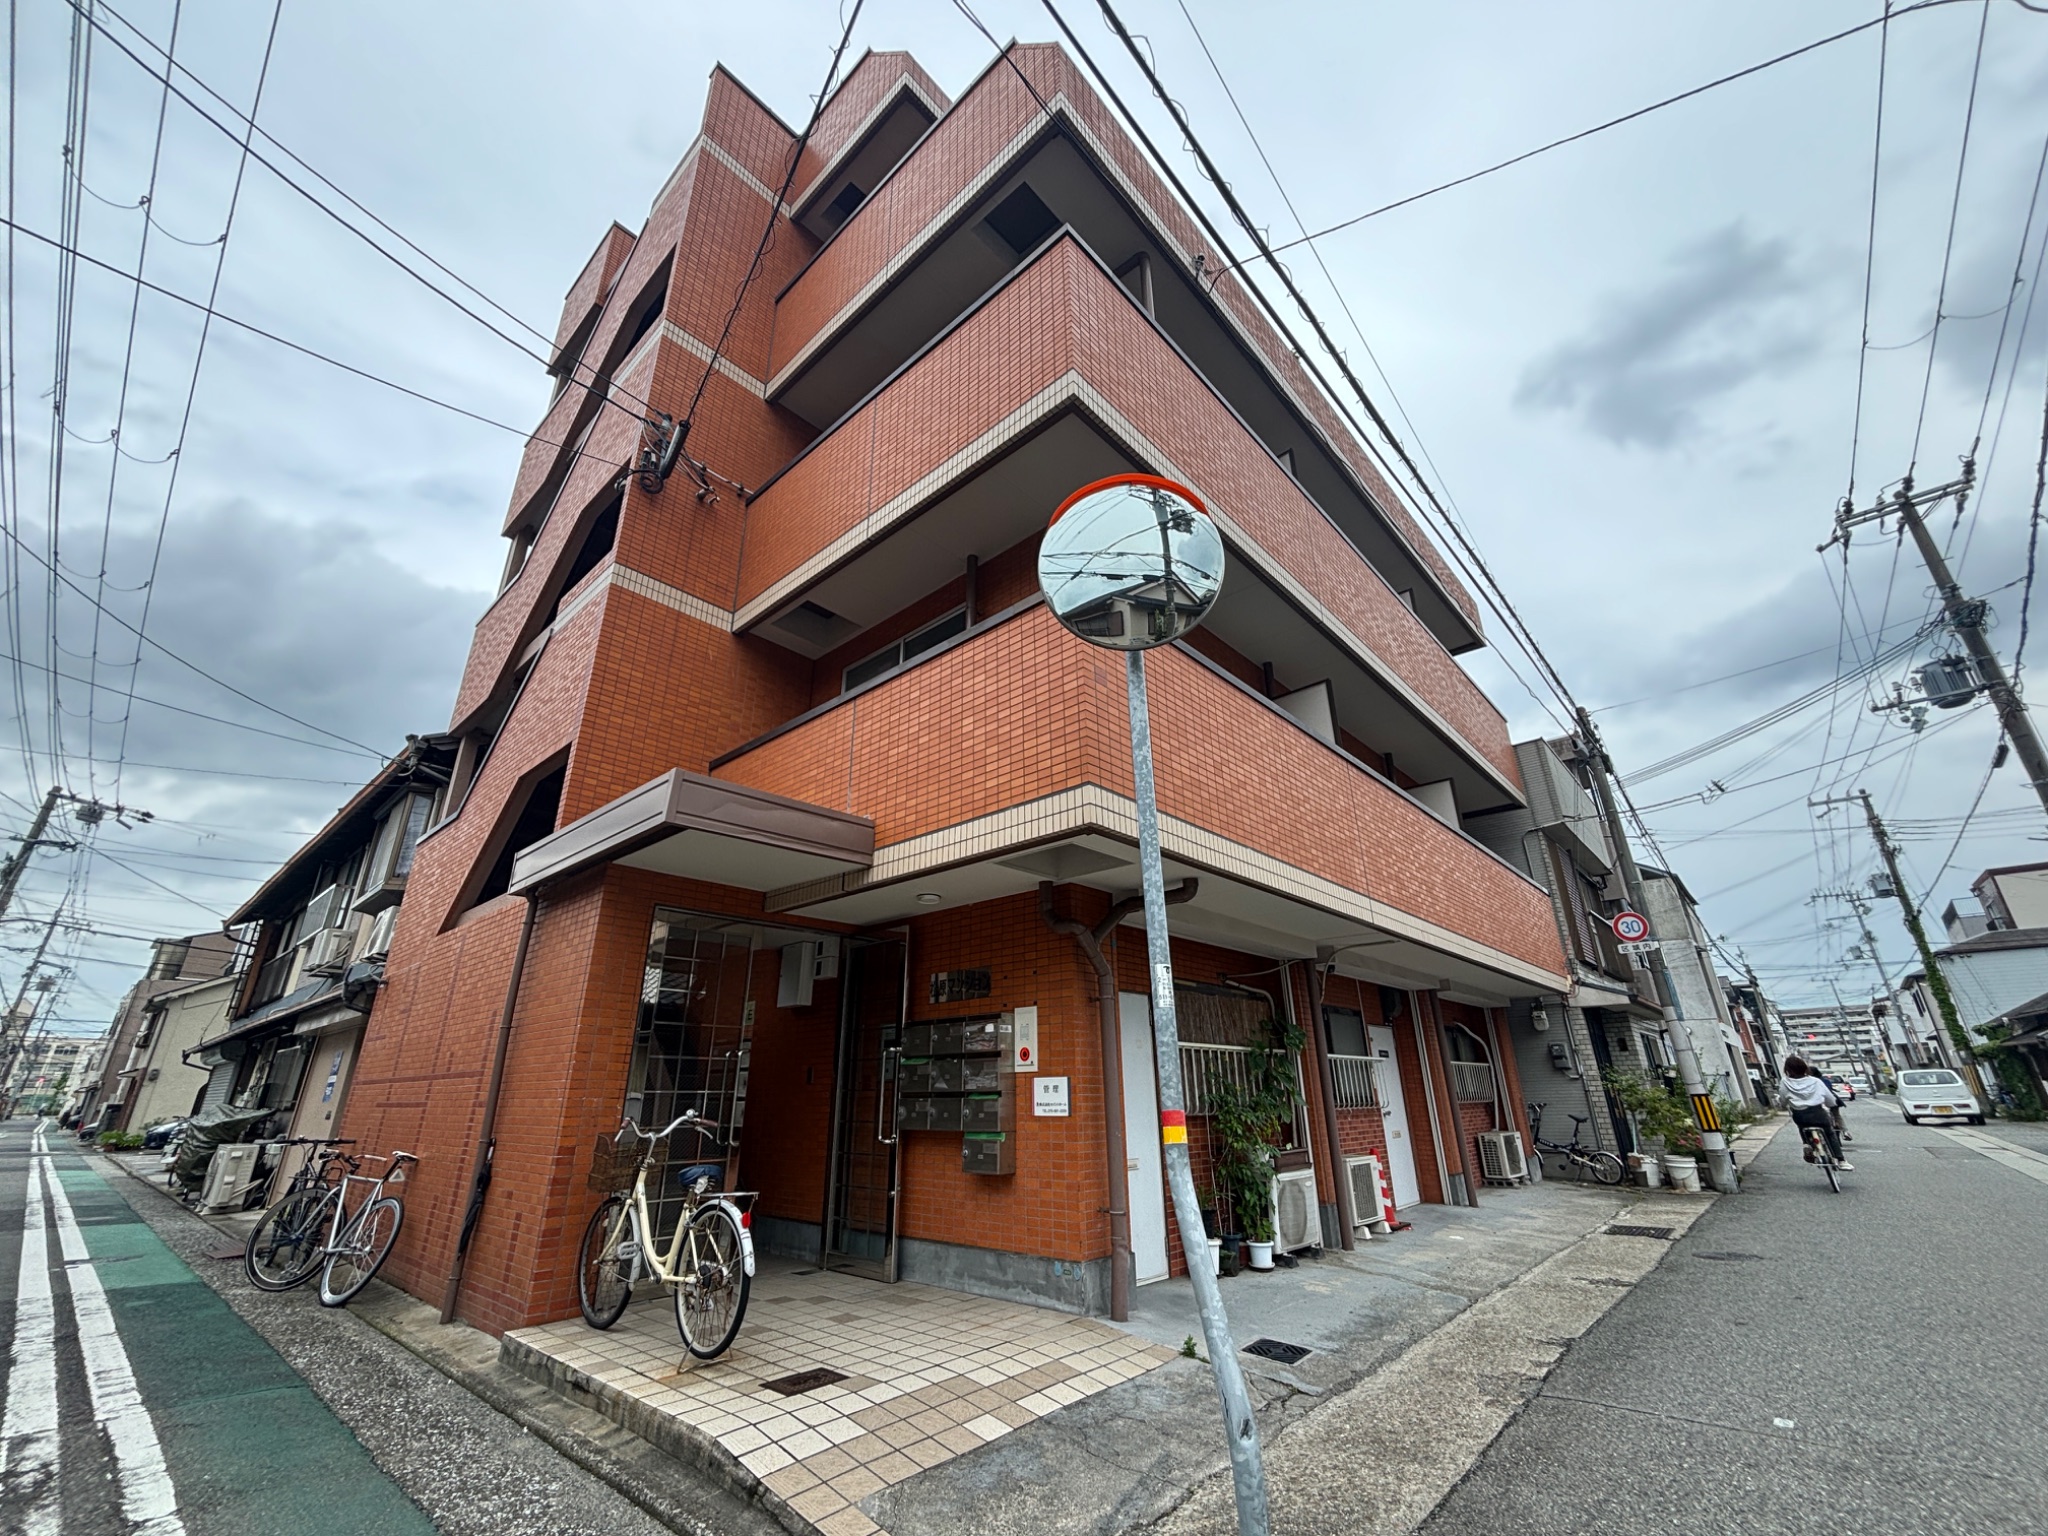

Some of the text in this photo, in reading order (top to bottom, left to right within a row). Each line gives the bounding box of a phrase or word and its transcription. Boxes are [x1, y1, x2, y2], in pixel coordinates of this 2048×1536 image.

[1621, 920, 1641, 934] 30
[1621, 943, 1652, 952] 区域内
[1043, 1084, 1059, 1094] 管理
